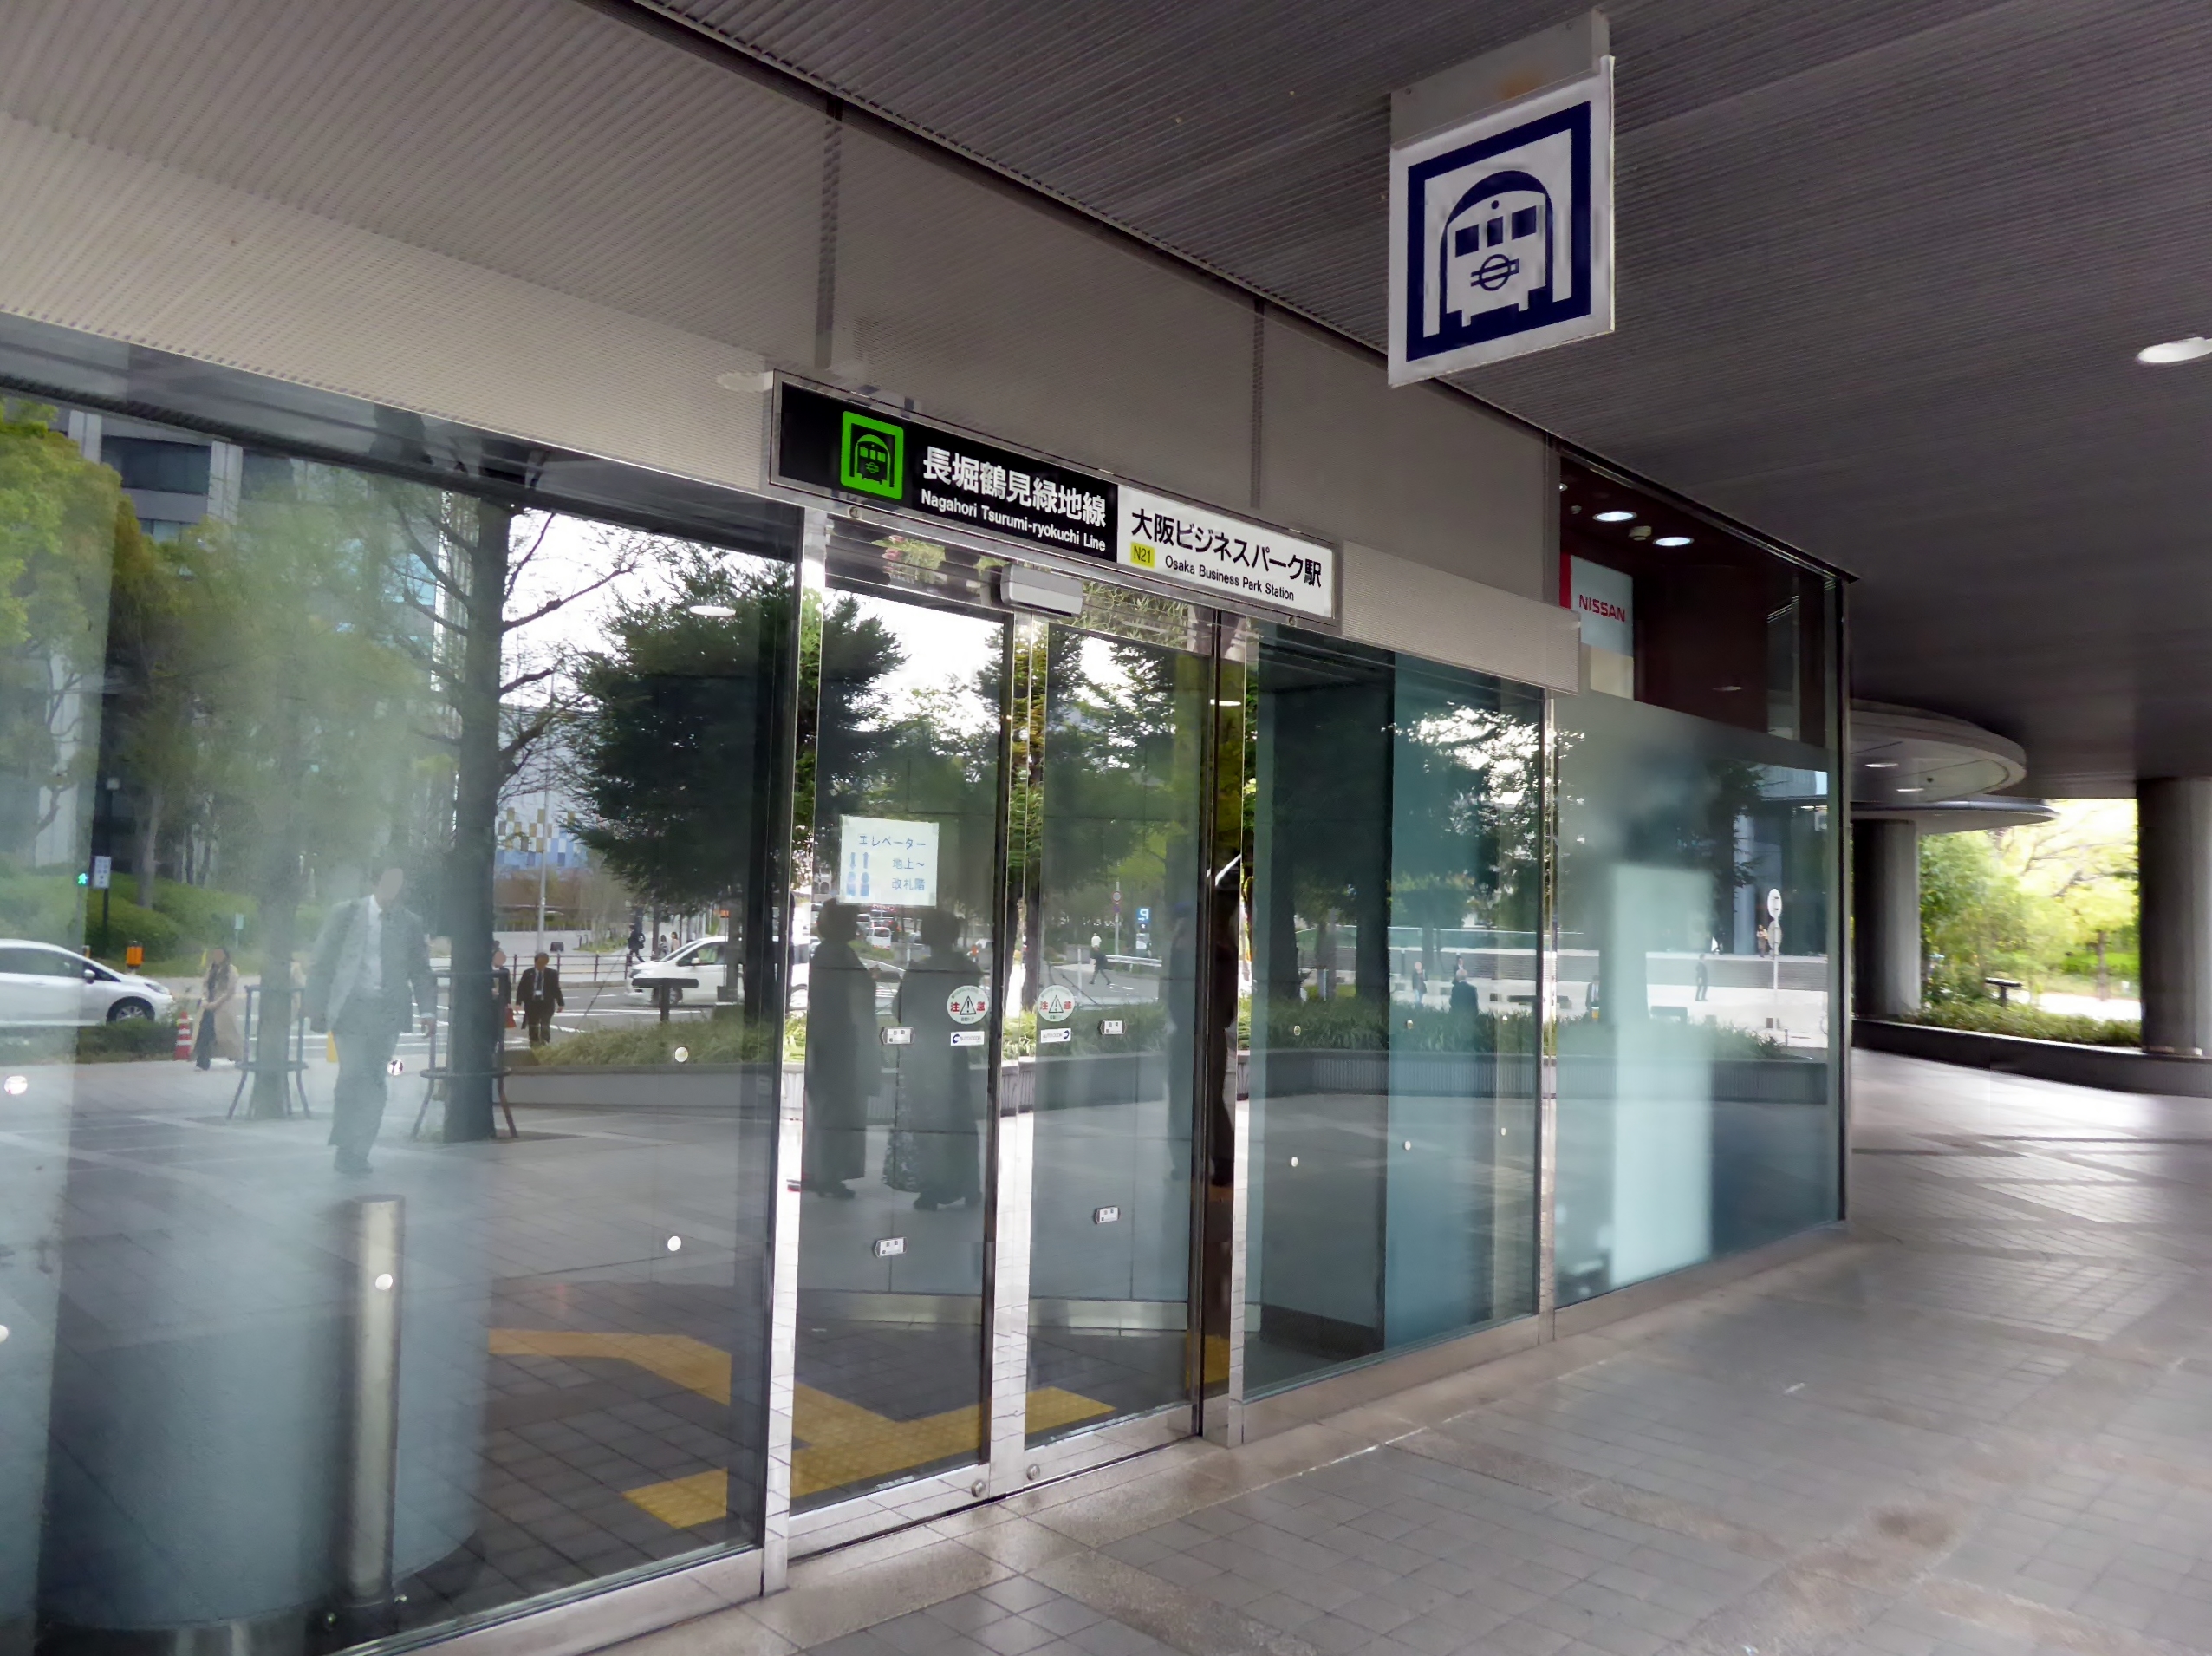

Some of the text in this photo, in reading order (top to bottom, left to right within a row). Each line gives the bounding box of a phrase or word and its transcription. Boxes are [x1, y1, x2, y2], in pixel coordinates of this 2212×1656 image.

[923, 446, 1106, 527] 長堀鶴見緑地線
[921, 488, 1106, 551] Nagahori Tsurumi-ryokuchi Line
[1131, 508, 1322, 588] 大阪ビジネスパーク駅
[1133, 545, 1152, 564] N21
[1165, 555, 1294, 602] Osaka Business Park Station
[1578, 594, 1626, 622] NISSAN
[859, 835, 926, 850] エレベーター
[891, 877, 926, 891] 改札階
